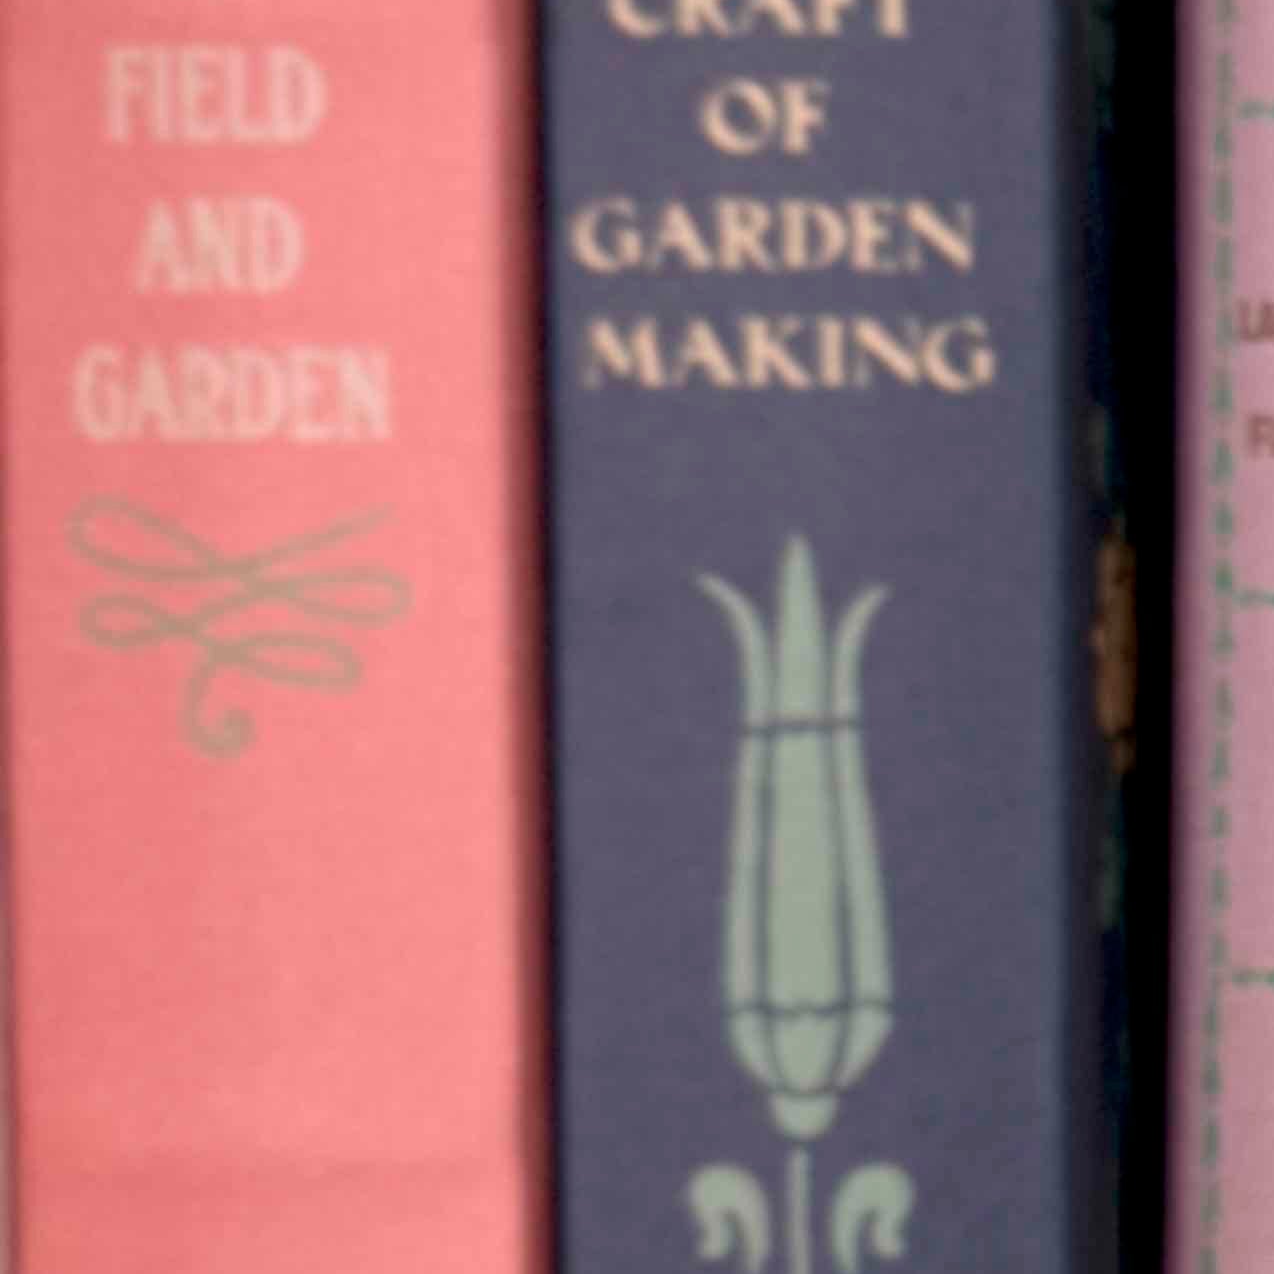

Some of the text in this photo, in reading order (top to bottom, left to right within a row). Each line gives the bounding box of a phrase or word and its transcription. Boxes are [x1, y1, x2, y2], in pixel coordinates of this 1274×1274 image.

[102, 44, 329, 144] FIELD
[698, 78, 828, 155] OF
[135, 196, 306, 293] AND
[567, 196, 976, 274] GARDEN
[70, 346, 391, 443] GARDEN
[580, 316, 998, 394] MAKING
